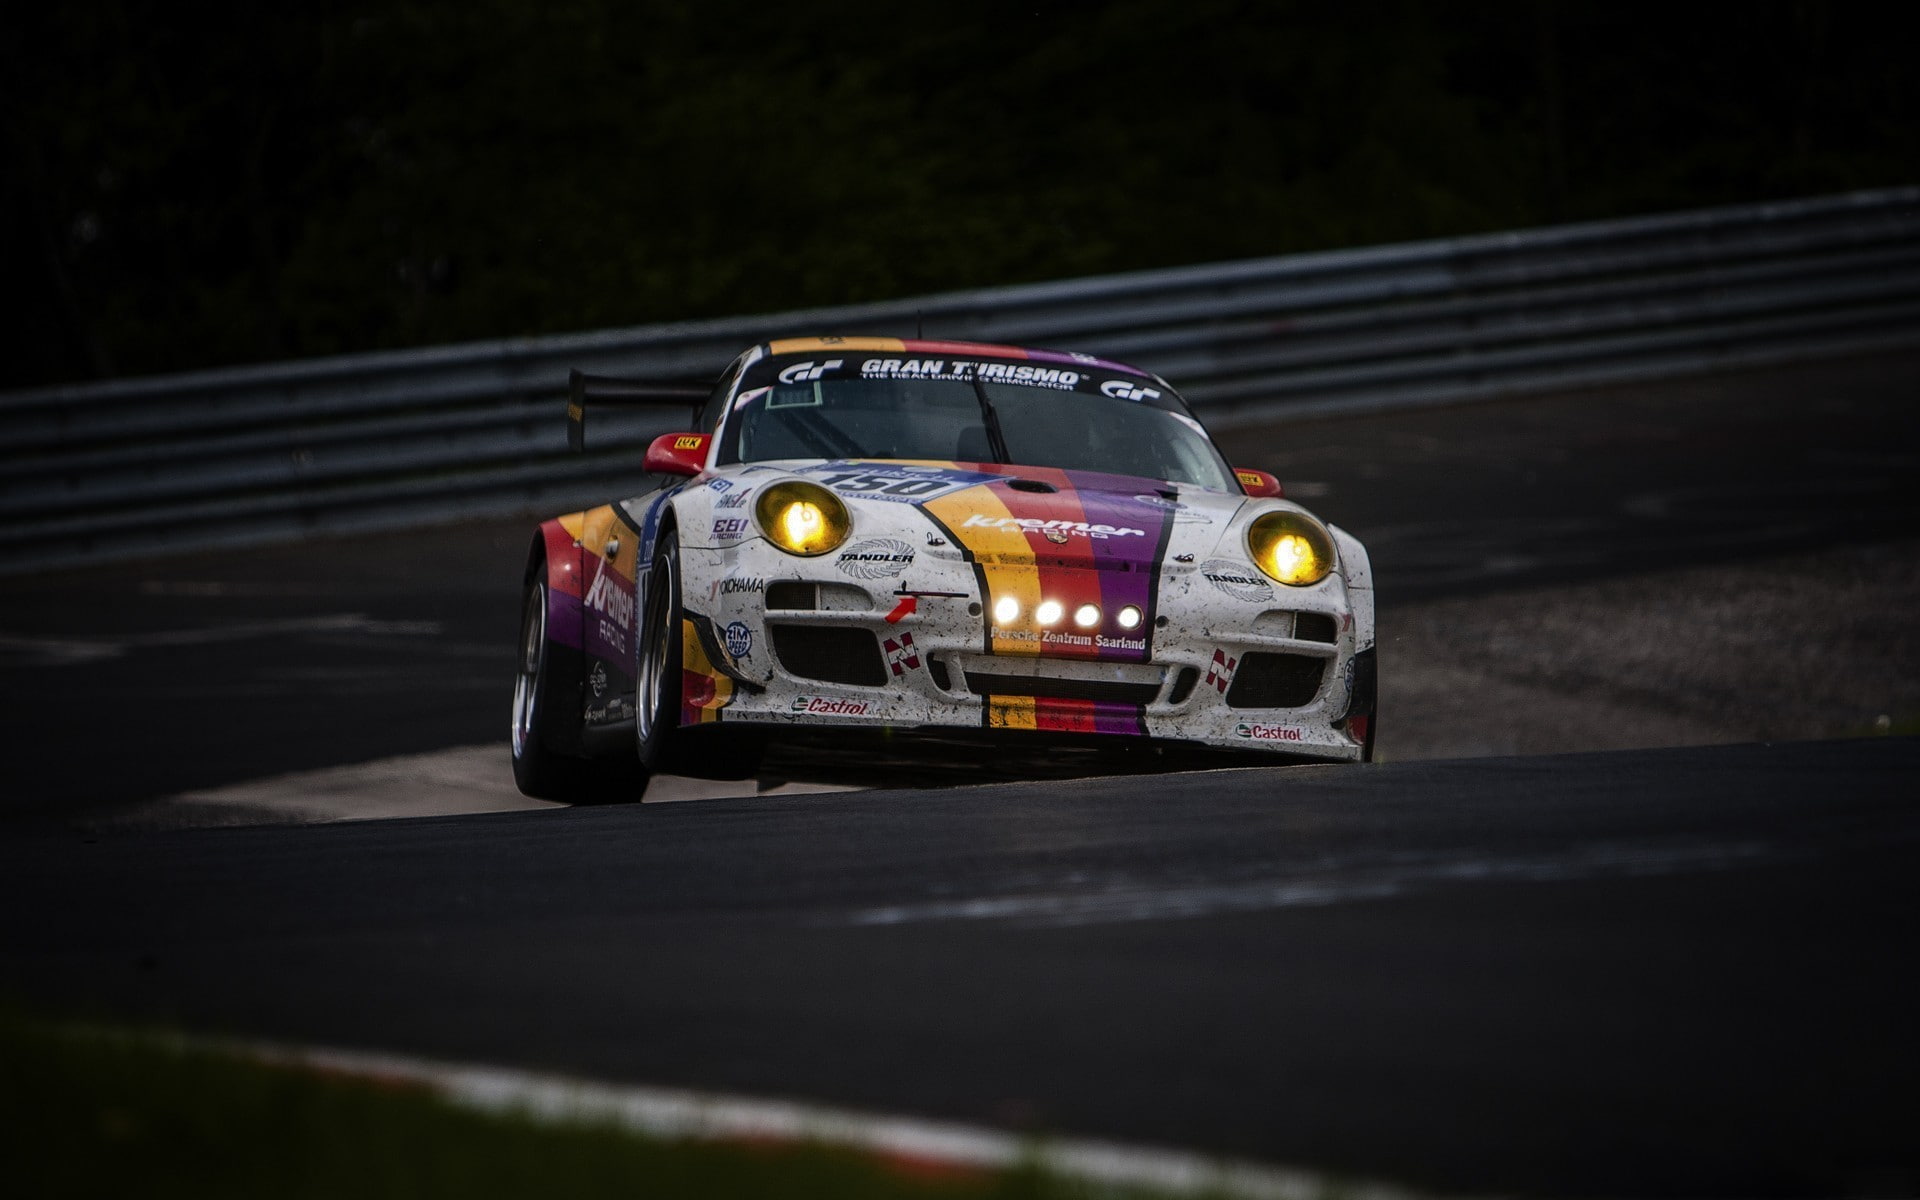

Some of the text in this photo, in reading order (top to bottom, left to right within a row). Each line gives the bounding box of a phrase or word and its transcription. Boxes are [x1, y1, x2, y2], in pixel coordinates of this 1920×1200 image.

[861, 358, 944, 374] GRAN
[992, 376, 1075, 391] SIMULATOR
[821, 474, 951, 496] 150
[962, 514, 1145, 537] kremer
[1001, 526, 1109, 540] RACING
[841, 553, 914, 564] TANDLER
[1204, 573, 1270, 587] TANDLER
[584, 557, 635, 630] kremer
[709, 577, 765, 601] YOKOHAMA
[599, 619, 626, 655] RACING
[1042, 630, 1092, 646] Zentrum
[1095, 634, 1146, 650] Saarland
[728, 640, 748, 654] SPEED
[808, 697, 868, 716] Castrol
[1252, 725, 1302, 741] Castrol
